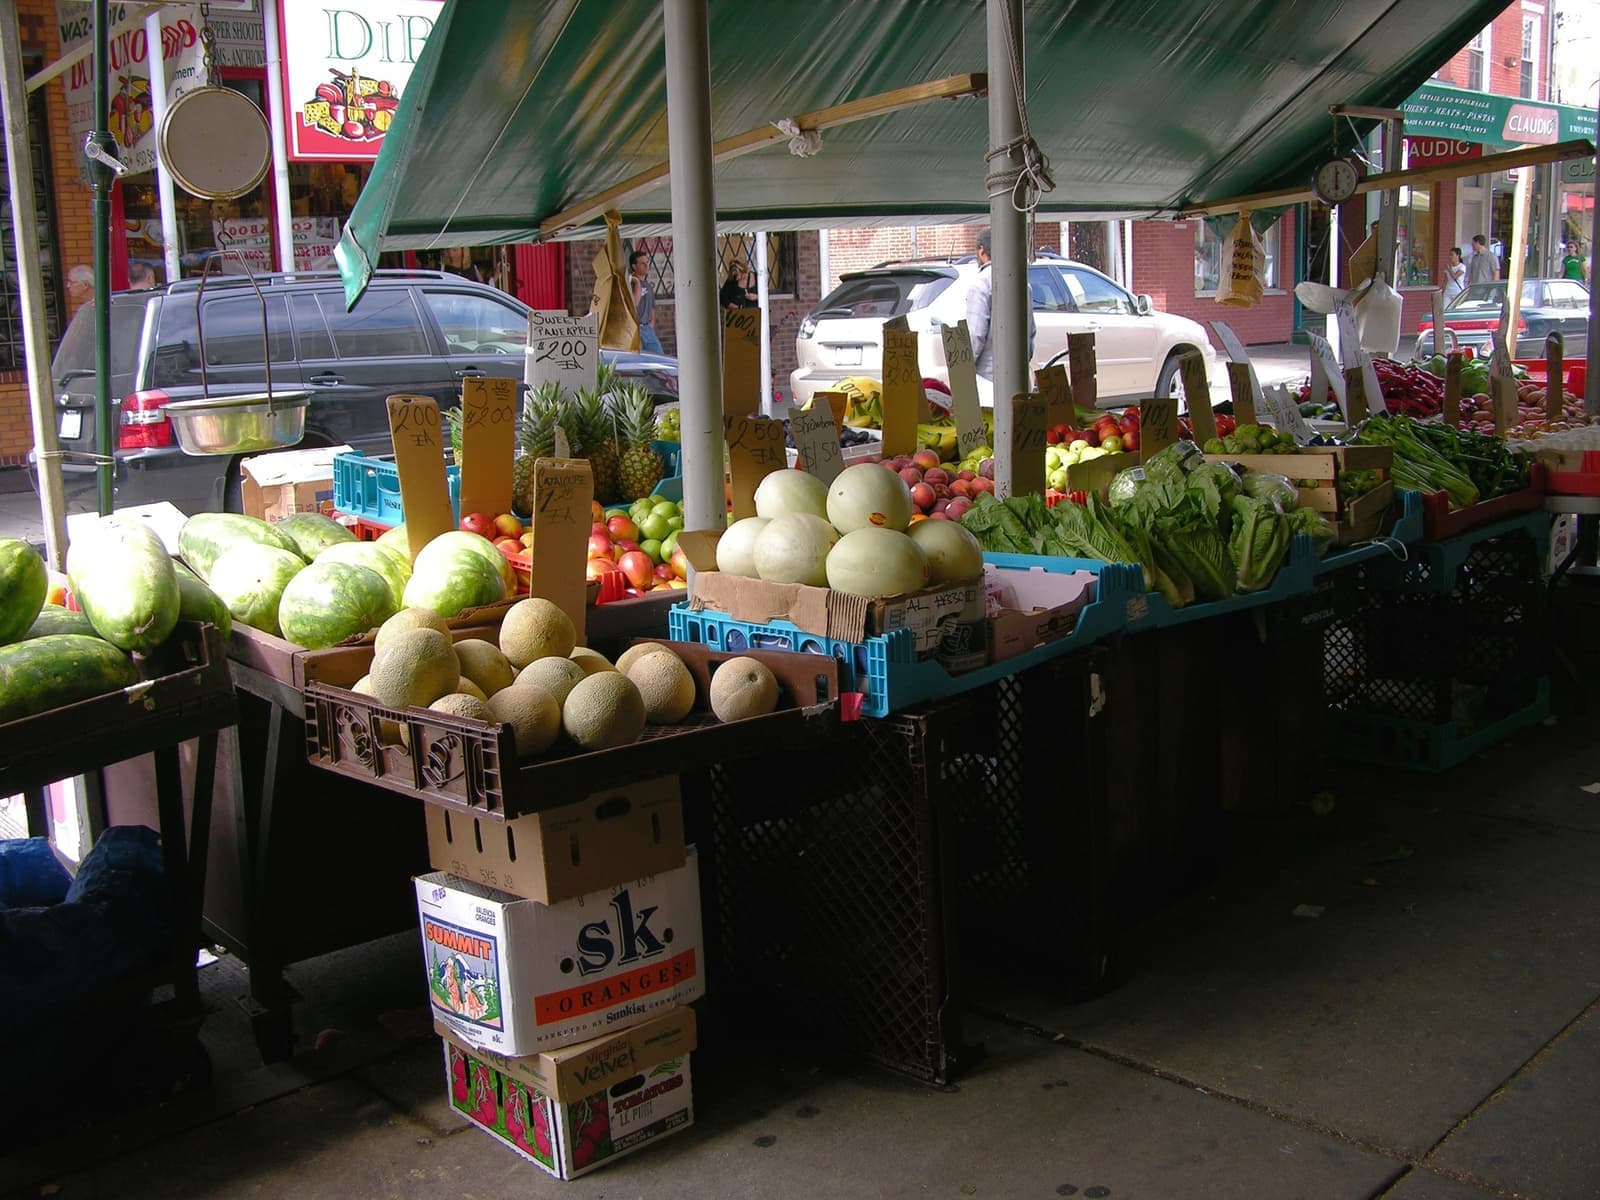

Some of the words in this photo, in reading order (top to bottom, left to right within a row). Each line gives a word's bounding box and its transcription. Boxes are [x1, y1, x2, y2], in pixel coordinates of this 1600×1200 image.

[322, 8, 434, 63] DIB
[1434, 107, 1461, 117] MEATS
[1466, 112, 1496, 122] PASTAS
[533, 312, 581, 325] SWEET
[425, 921, 491, 960] SUMMIT
[558, 960, 682, 1013] ORANGES
[536, 1024, 589, 1042] MARKETED
[592, 1017, 604, 1029] BY
[606, 1002, 647, 1025] Sunkist
[574, 1048, 636, 1086] Velvet
[586, 1040, 628, 1063] Virginia
